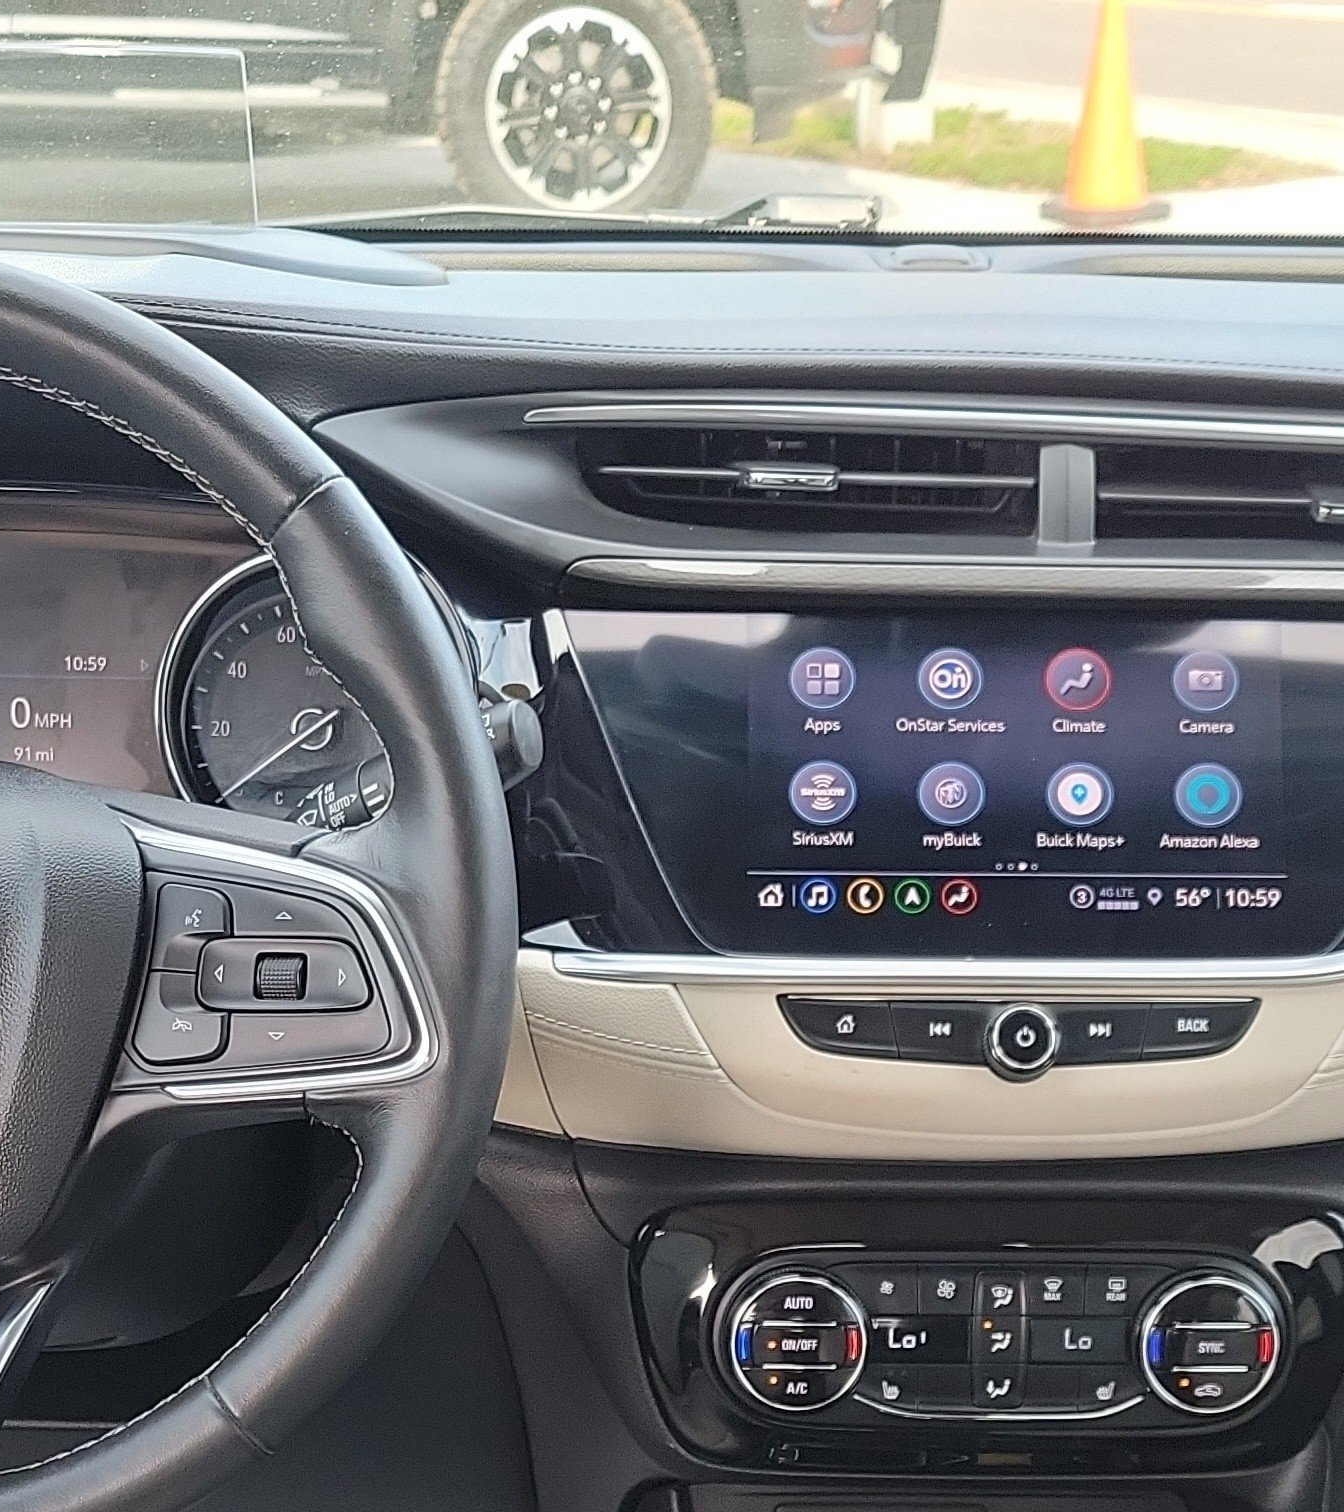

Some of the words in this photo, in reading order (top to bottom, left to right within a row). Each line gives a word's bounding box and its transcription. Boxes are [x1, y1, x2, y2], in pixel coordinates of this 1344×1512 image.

[277, 626, 296, 643] 60
[64, 656, 107, 672] 10:59
[227, 662, 247, 678] 40
[10, 697, 31, 728] 0
[35, 713, 72, 728] MPH
[211, 721, 230, 737] 20
[804, 717, 841, 734] Apps
[896, 718, 945, 732] OnStar
[948, 719, 1005, 732] Services
[1053, 719, 1106, 733] Climate
[1180, 720, 1234, 734] Camera
[14, 747, 31, 761] 91
[35, 747, 53, 762] mi
[275, 791, 283, 805] C
[329, 796, 350, 814] AUTO
[330, 812, 346, 828] OFF
[793, 831, 854, 846] SiriusXM
[923, 832, 982, 850] myBuick
[1036, 832, 1073, 847] Buick
[1076, 833, 1125, 850] Maps+
[1160, 834, 1217, 848] Amazon
[1220, 834, 1260, 849] Alexa
[1099, 888, 1114, 898] 4G
[1116, 888, 1134, 898] LTE
[1226, 888, 1282, 908] 10:59
[1178, 1018, 1210, 1032] BACK
[784, 1297, 813, 1310] AUTO
[1044, 1292, 1061, 1301] MAX
[782, 1340, 818, 1351] ON/OFF
[1198, 1342, 1225, 1354] SYNC
[786, 1383, 808, 1395] A/C
